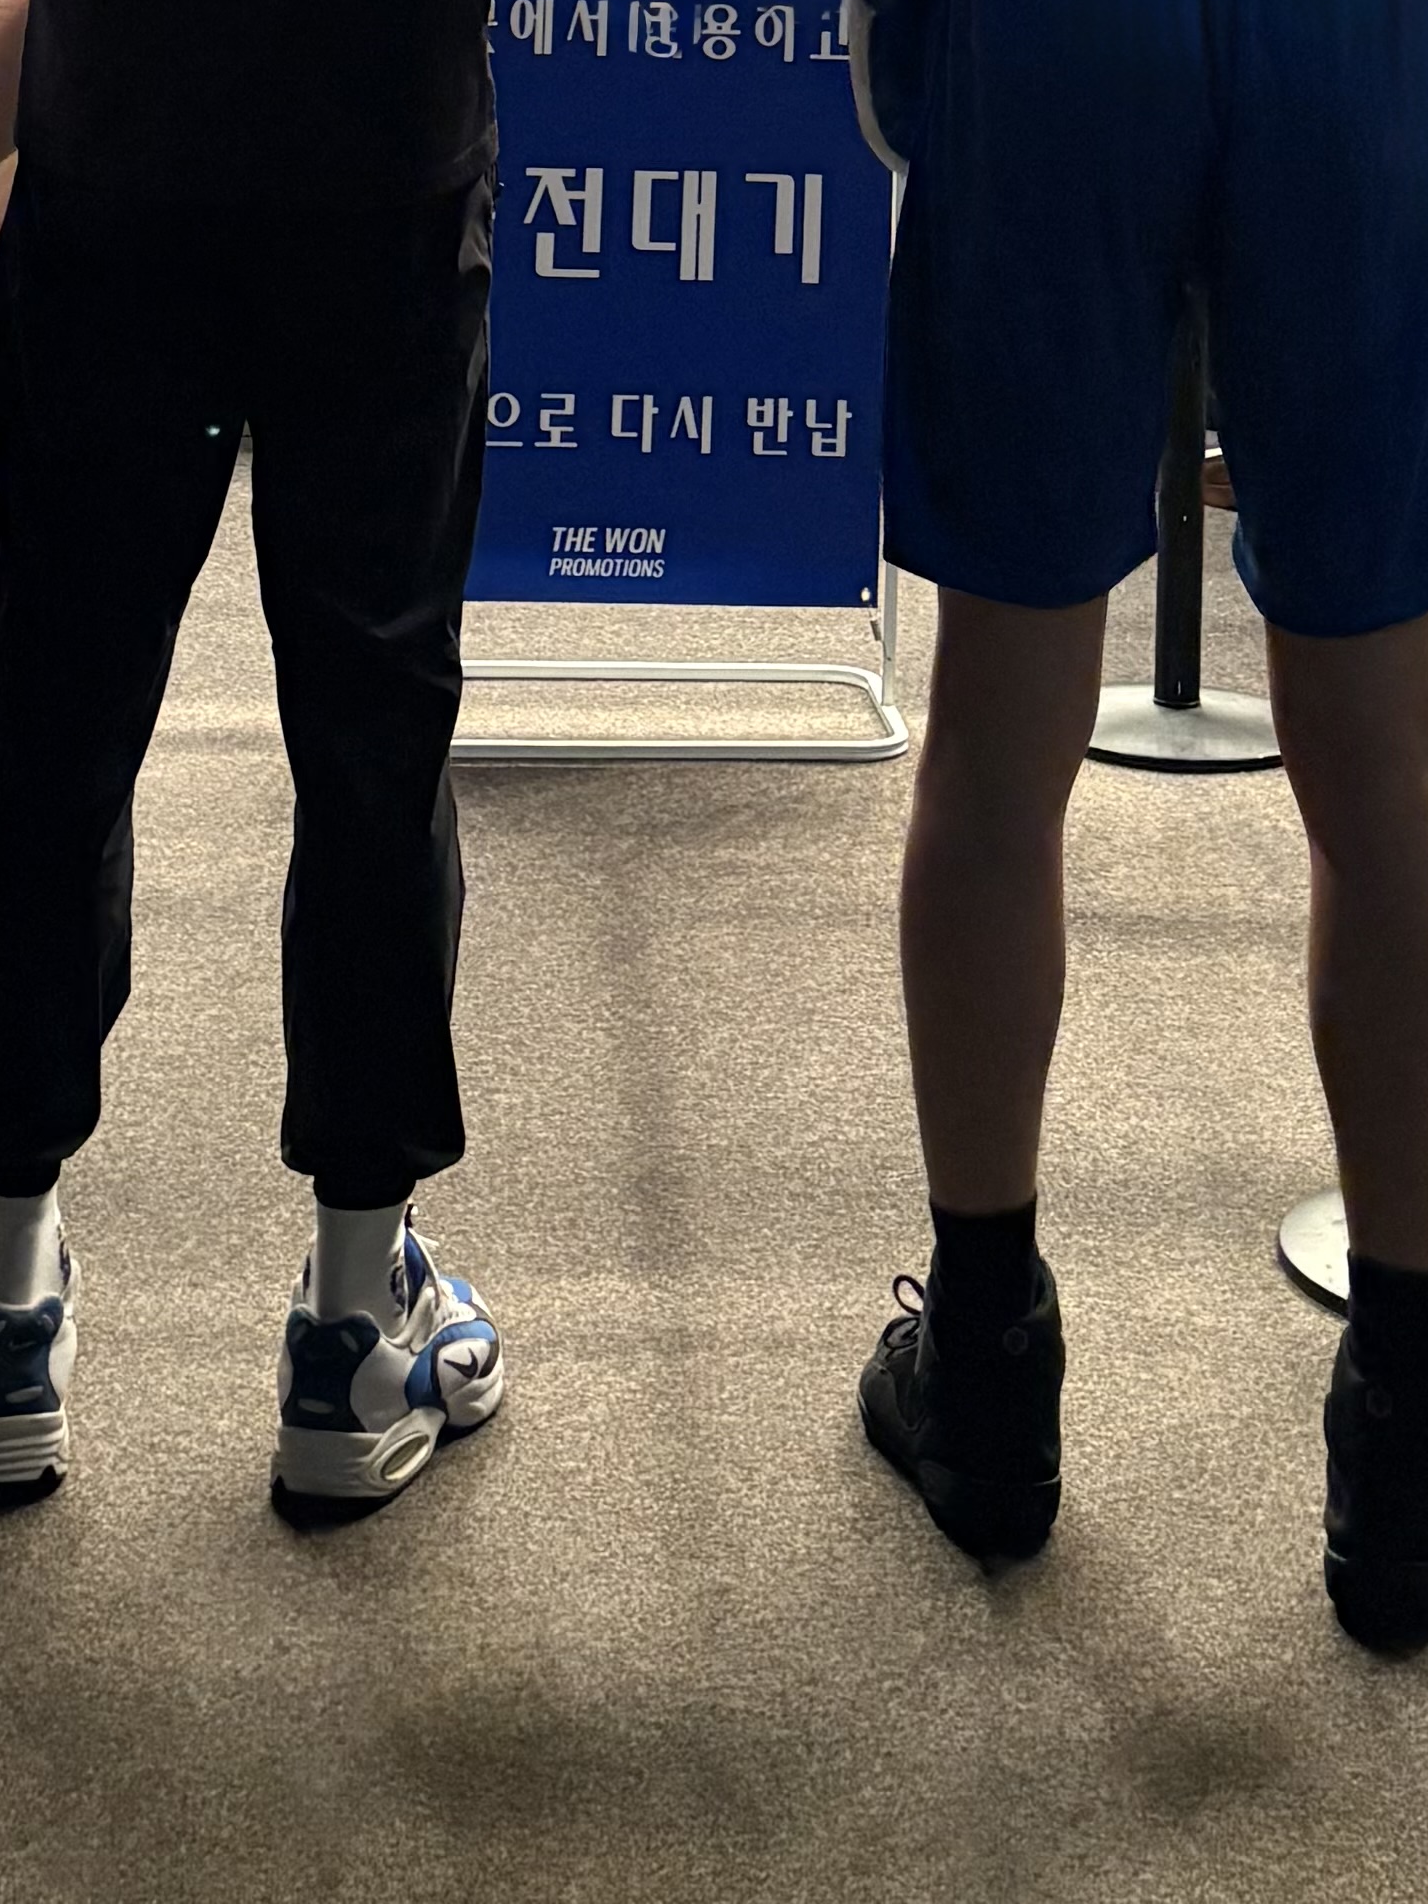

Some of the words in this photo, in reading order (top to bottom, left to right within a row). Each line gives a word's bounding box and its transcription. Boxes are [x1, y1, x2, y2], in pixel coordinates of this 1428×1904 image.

[523, 167, 823, 284] 전대기
[611, 393, 714, 455] 다시
[747, 396, 853, 458] 반납
[551, 526, 598, 553] THE
[605, 526, 666, 554] WON
[549, 558, 665, 579] PROMOTIONS
